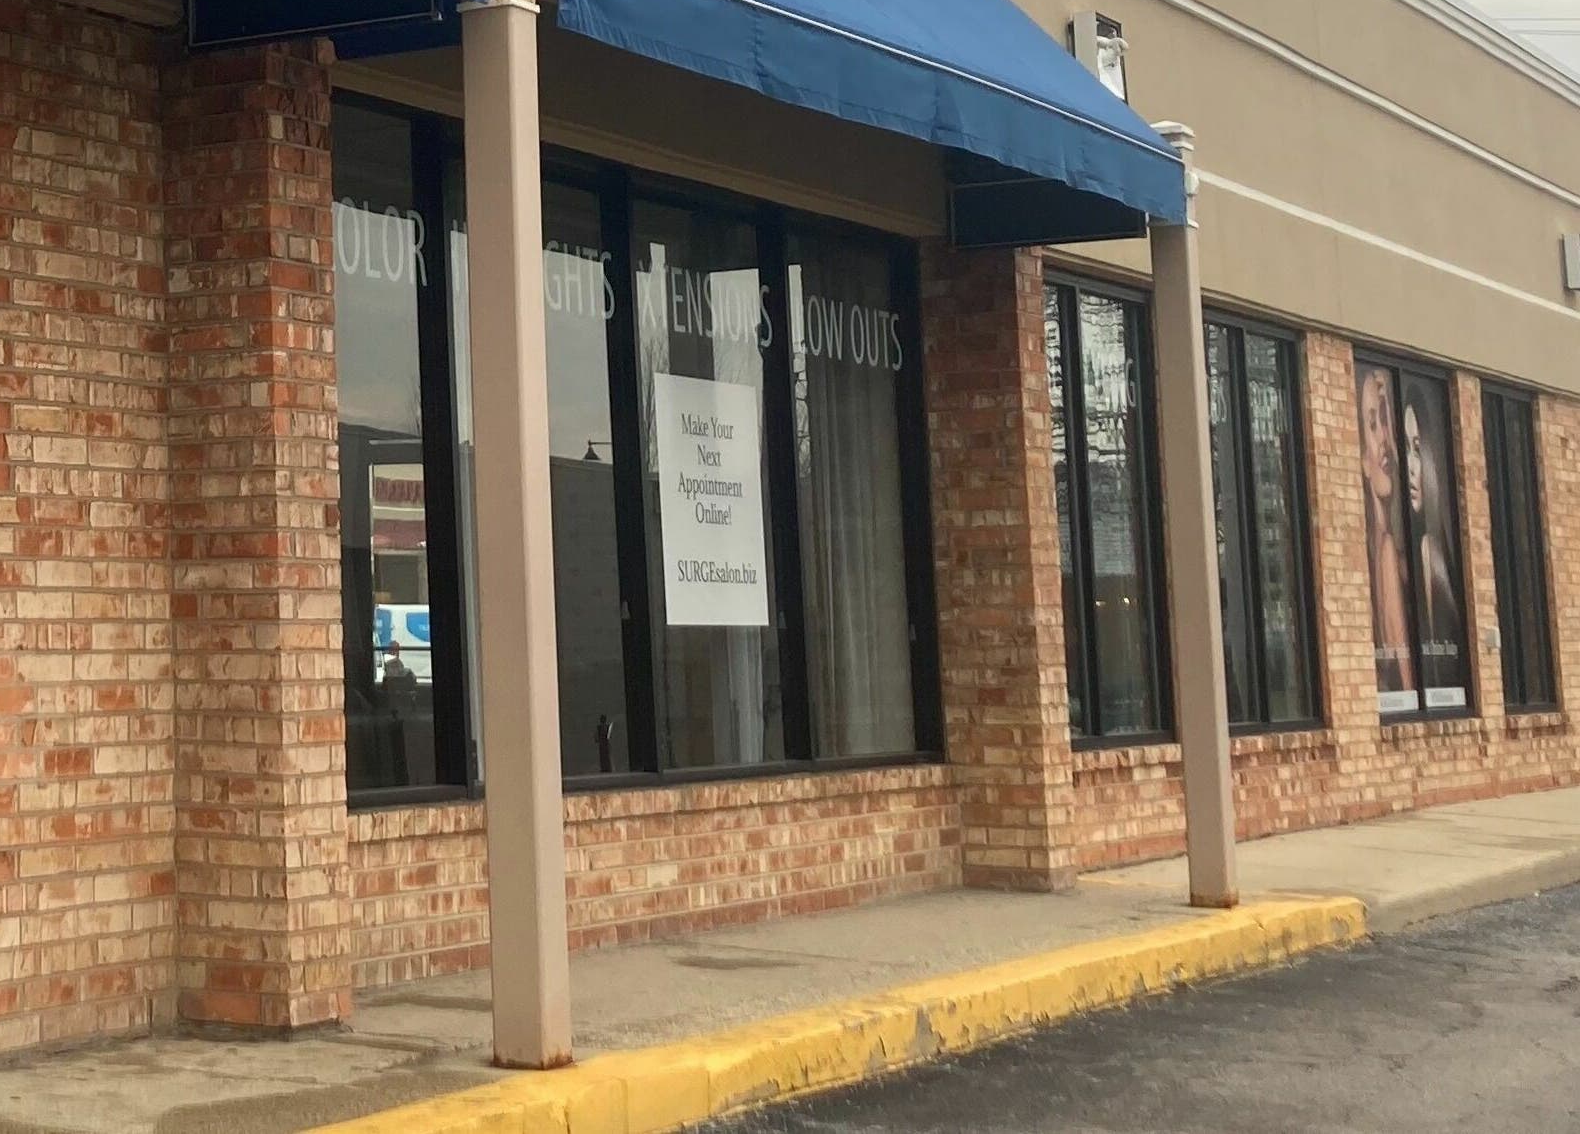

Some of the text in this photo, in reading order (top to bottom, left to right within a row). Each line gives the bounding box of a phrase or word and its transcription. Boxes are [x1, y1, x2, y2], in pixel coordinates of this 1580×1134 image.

[335, 197, 427, 287] OLOR
[637, 259, 773, 348] XTENSIONS
[850, 304, 903, 371] OUTS
[681, 413, 734, 439] Make Your
[697, 444, 722, 467] Next
[678, 472, 743, 500] Appointment
[695, 502, 732, 525] Online!
[678, 559, 757, 584] SURGEsalon.biz
